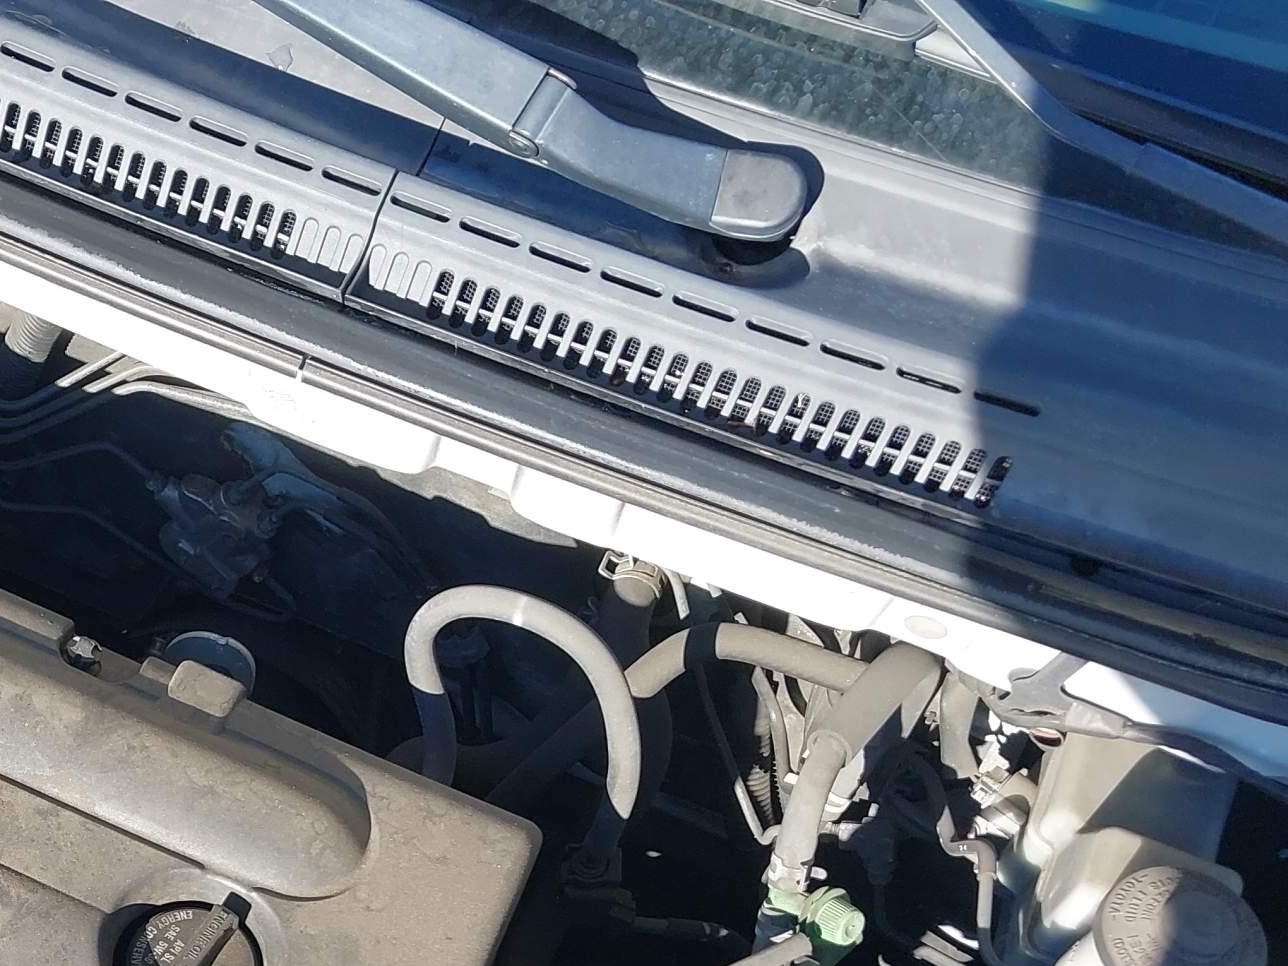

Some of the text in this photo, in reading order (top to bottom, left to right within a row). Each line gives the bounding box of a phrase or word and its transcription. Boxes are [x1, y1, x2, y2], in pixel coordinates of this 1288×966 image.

[157, 910, 193, 929] ENERGY
[164, 924, 181, 941] SAE
[160, 938, 185, 964] API SL
